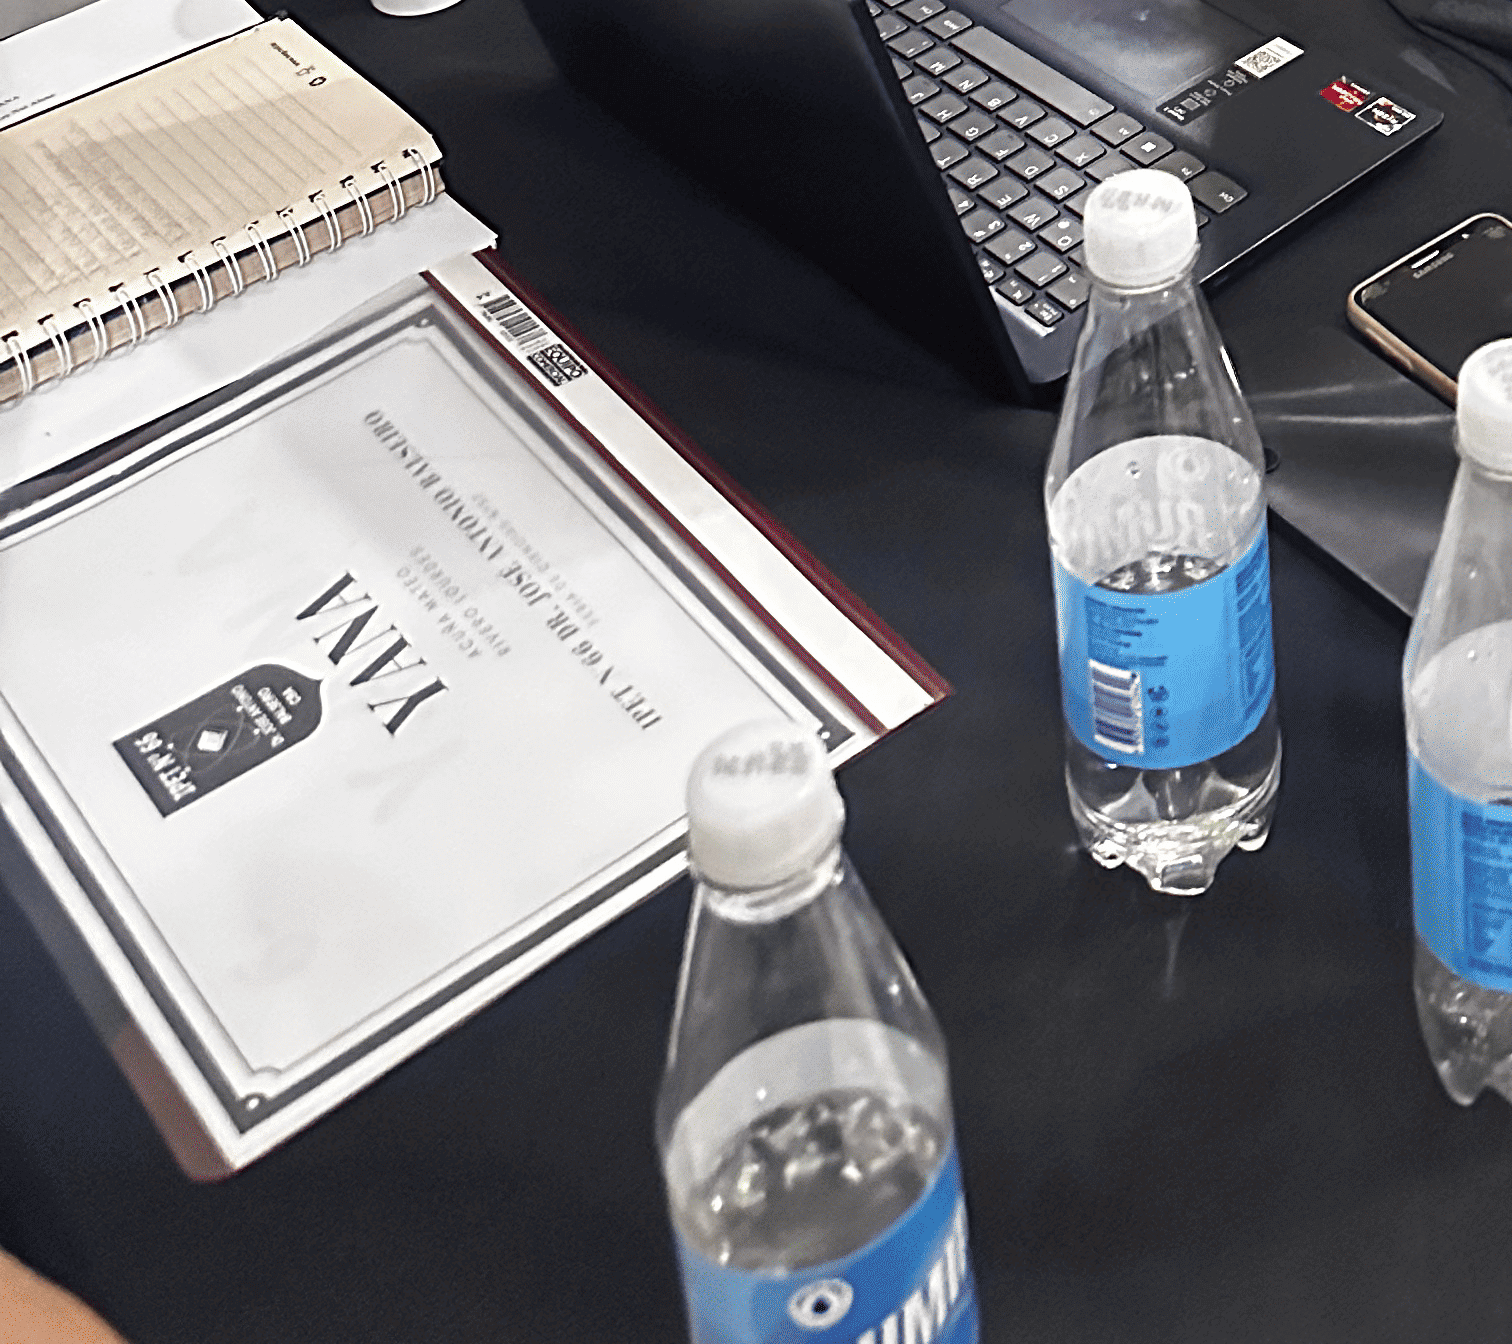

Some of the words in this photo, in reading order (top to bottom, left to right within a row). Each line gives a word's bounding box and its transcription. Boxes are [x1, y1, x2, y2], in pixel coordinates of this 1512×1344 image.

[363, 408, 441, 490] BALSEIRO
[433, 484, 504, 562] ANTONIO
[396, 565, 439, 613] MATEO
[294, 570, 450, 740] YANA
[609, 683, 663, 730] IPET
